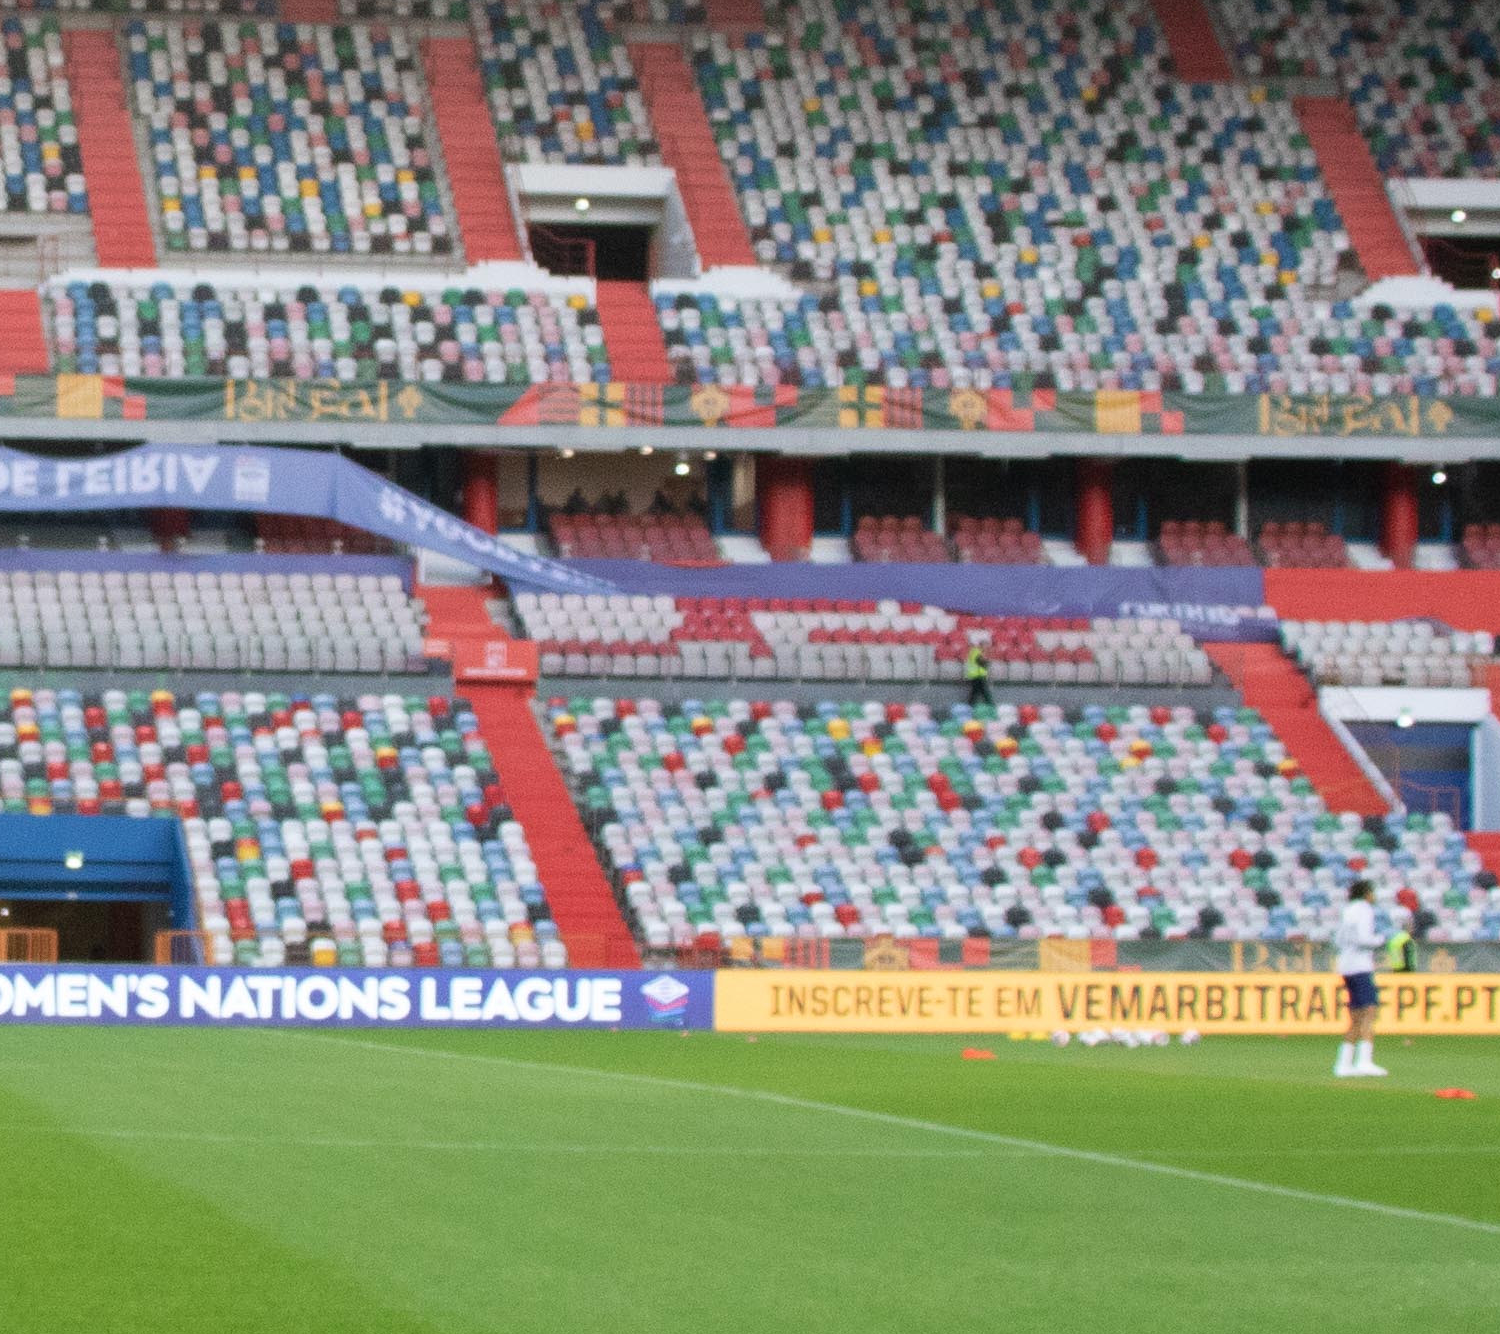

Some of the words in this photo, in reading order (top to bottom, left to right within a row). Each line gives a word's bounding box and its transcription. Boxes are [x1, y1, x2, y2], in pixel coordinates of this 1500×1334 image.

[179, 975, 412, 1021] NATIONS
[419, 977, 623, 1022] LEAGUE
[770, 984, 983, 1018] INSCREVE-TE
[995, 987, 1043, 1017] EM
